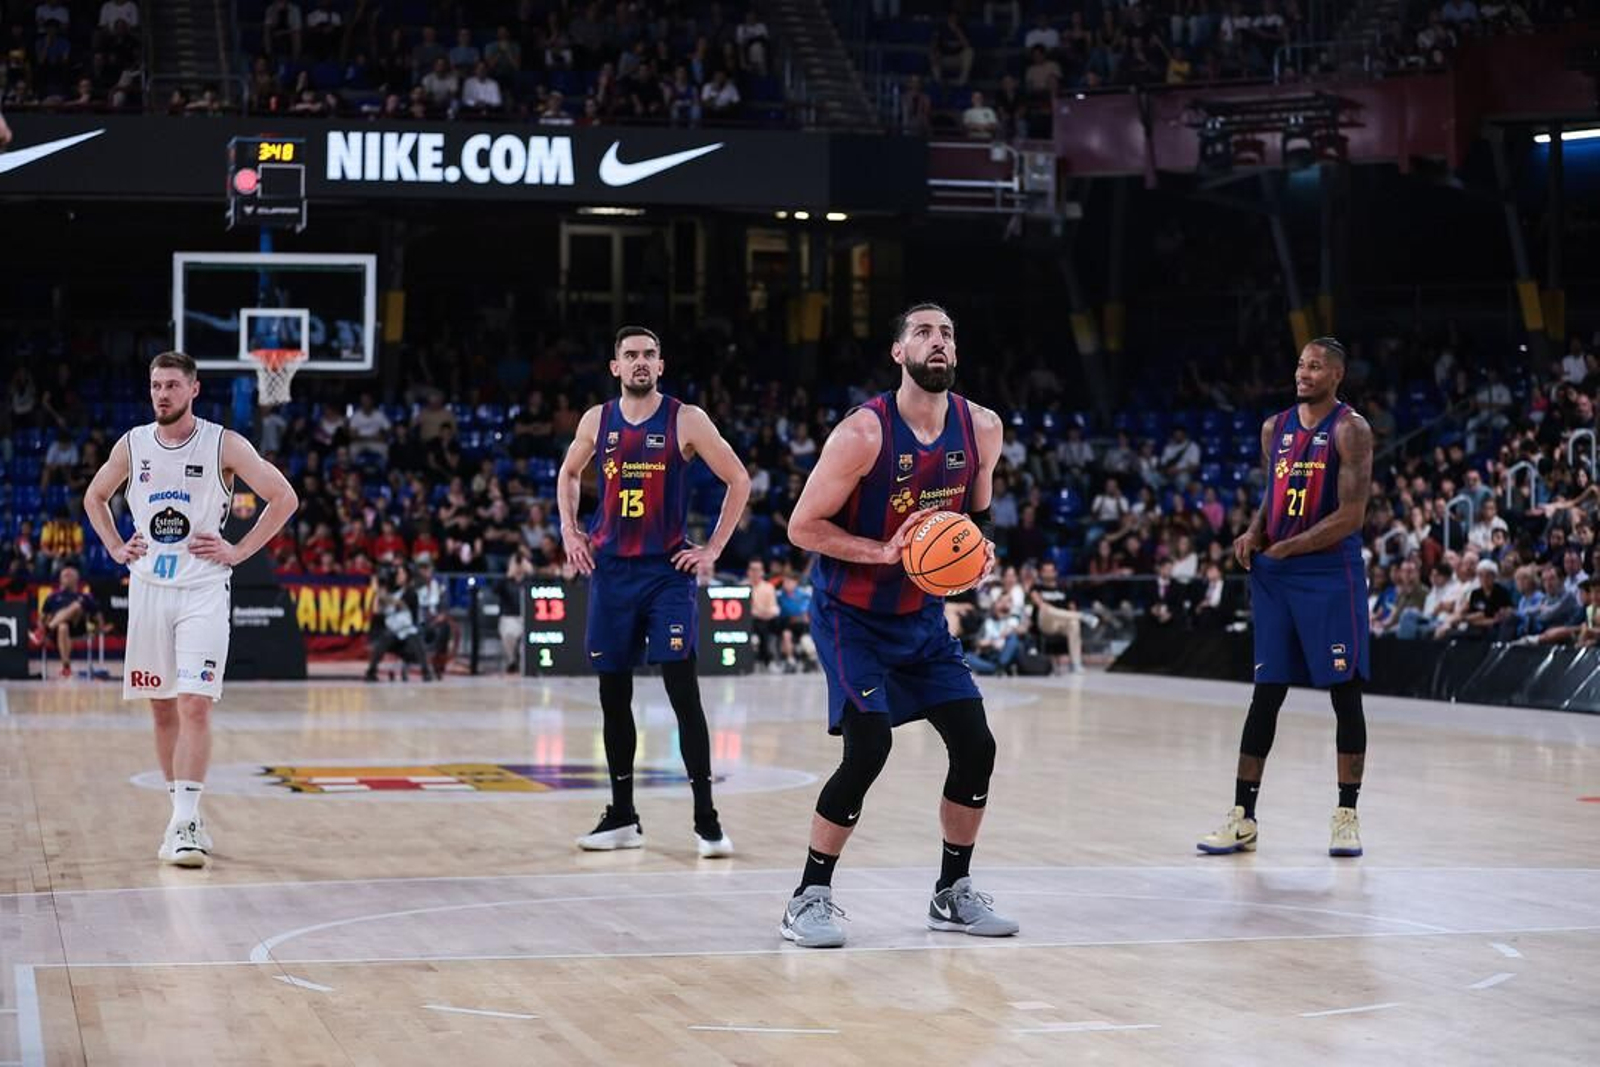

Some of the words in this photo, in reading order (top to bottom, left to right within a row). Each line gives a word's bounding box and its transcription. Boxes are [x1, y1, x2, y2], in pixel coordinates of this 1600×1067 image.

[327, 131, 575, 185] NIKE.COM
[618, 489, 645, 518] 13
[1286, 488, 1307, 516] 21
[153, 553, 178, 579] 47
[534, 599, 566, 621] 13
[711, 599, 743, 621] 10
[539, 648, 554, 667] 1
[130, 670, 162, 688] Rio
